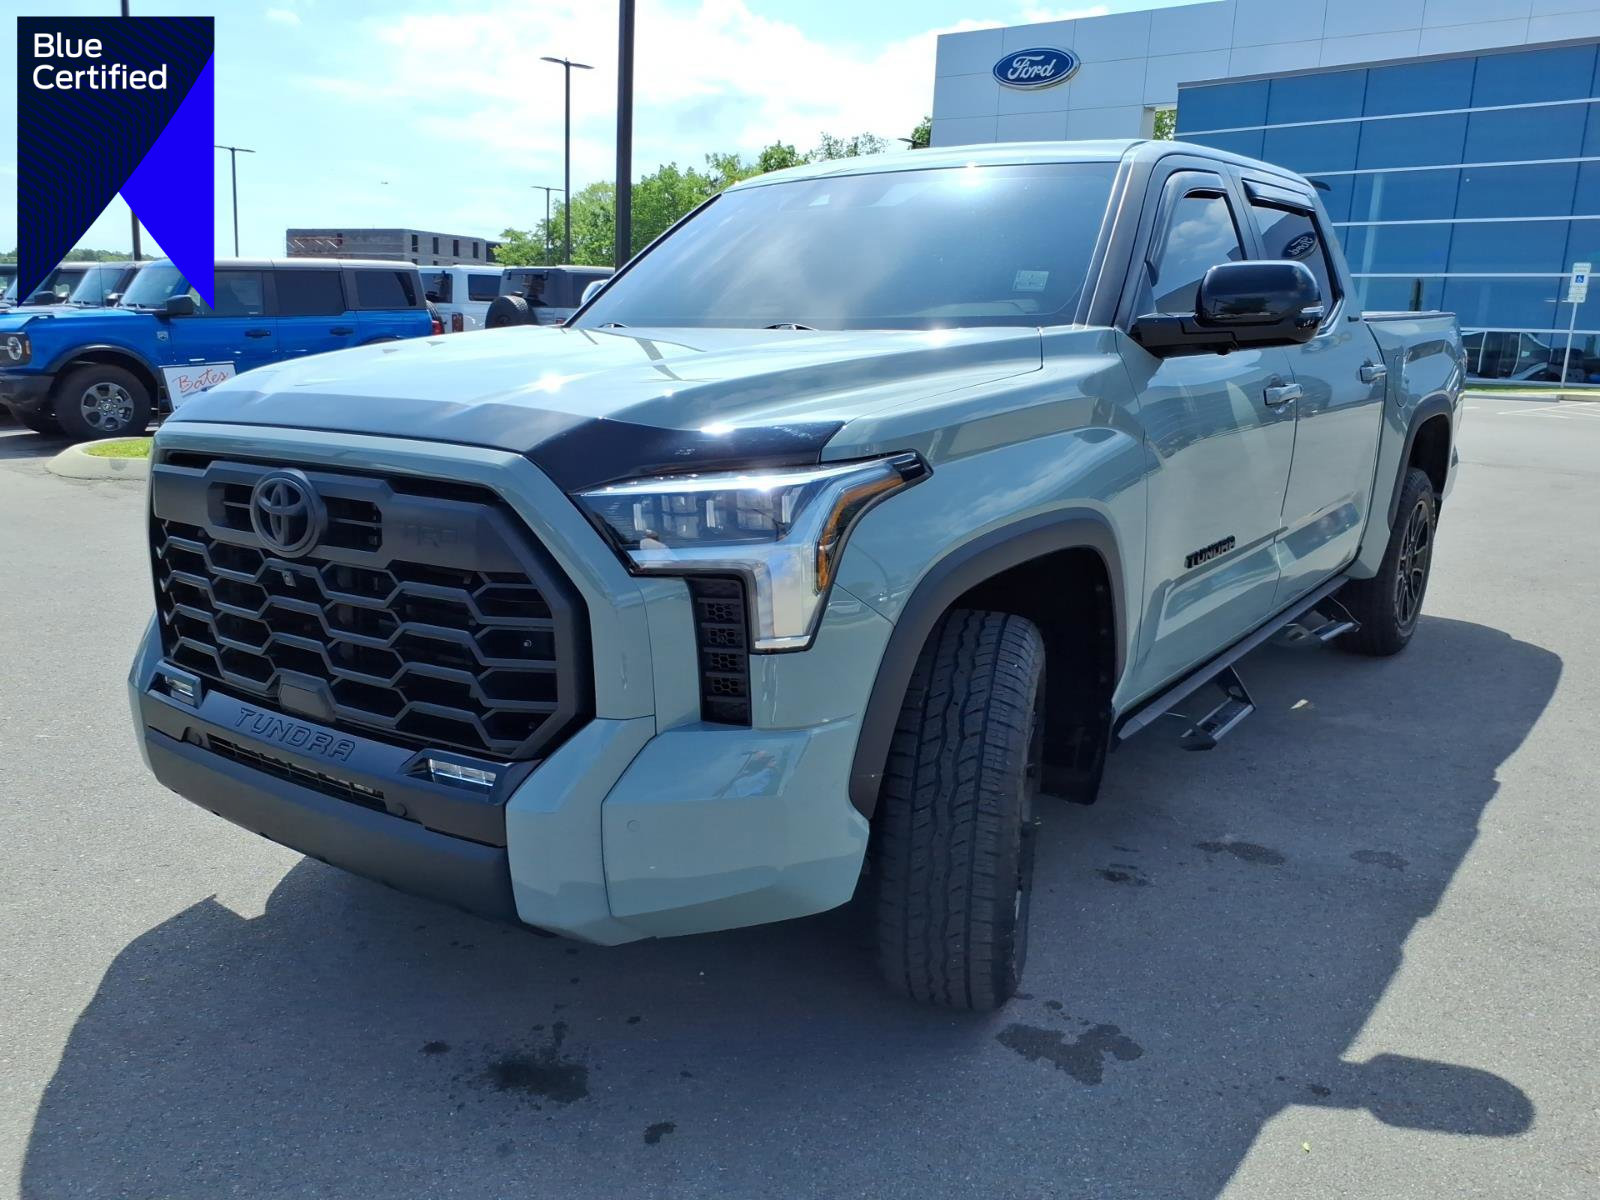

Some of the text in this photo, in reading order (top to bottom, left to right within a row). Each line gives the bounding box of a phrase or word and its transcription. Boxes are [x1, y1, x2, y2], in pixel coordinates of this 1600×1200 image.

[1007, 55, 1057, 80] Ford
[175, 368, 229, 393] Bates
[1184, 535, 1236, 569] TUNDRA
[235, 706, 356, 762] TUNDRA
